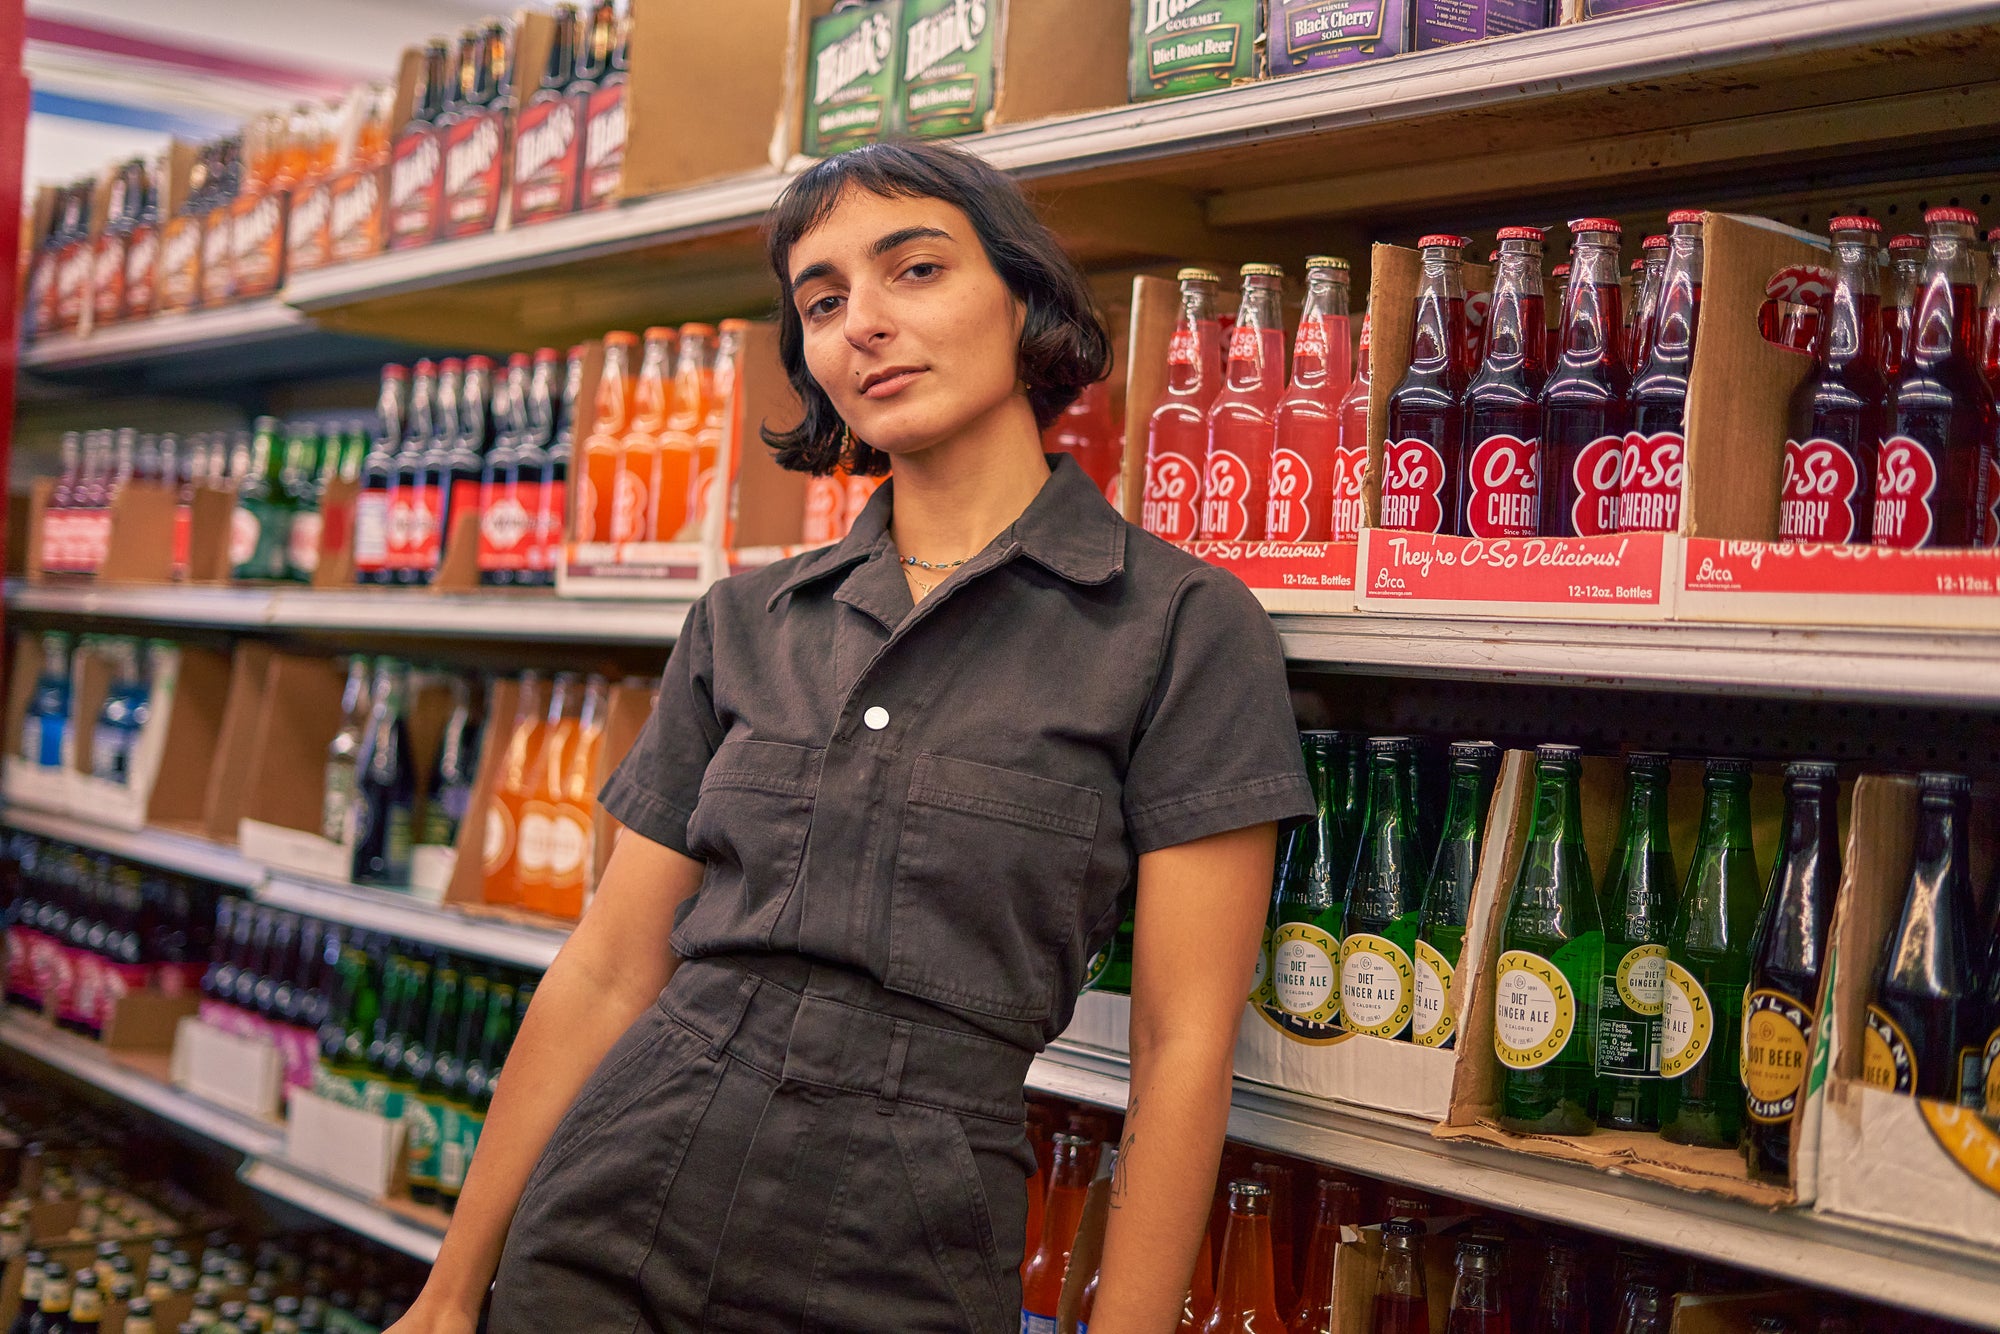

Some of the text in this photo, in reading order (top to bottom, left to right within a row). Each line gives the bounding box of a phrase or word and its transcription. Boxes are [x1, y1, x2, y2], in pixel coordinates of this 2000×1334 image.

[1165, 11, 1222, 32] GOURMET
[1295, 10, 1375, 37] Black Cherry
[1321, 29, 1344, 41] SODA
[1153, 38, 1233, 66] Diet Root Beer
[1332, 457, 1369, 496] O-S
[1382, 448, 1429, 489] O-So
[1621, 443, 1684, 488] O-So
[1781, 452, 1839, 494] O-So
[1877, 447, 1916, 494] -So
[1330, 498, 1360, 533] PEAC
[1381, 494, 1421, 527] HERRY
[1619, 492, 1677, 529] CHERRY
[1872, 499, 1906, 537] ERRY
[1503, 528, 1520, 536] Since
[1388, 533, 1629, 578] They're O-So Delicious!
[1282, 574, 1351, 587] 12-12oz. Bottles
[1374, 567, 1406, 589] Orca
[1696, 557, 1733, 582] Orca
[1568, 585, 1653, 599] 12-12oz. Bottles
[1275, 928, 1340, 965] OYLAN
[1290, 960, 1307, 973] DIET
[1343, 940, 1410, 978] OYLAN
[1420, 948, 1452, 990] LAN
[1622, 947, 1663, 970] BOYL
[1278, 972, 1327, 987] GINGER ALE
[1358, 972, 1375, 986] DIET
[1498, 957, 1567, 1001] OYLAN
[1629, 978, 1657, 988] GINGER
[1644, 970, 1660, 980] DIET
[1326, 990, 1341, 1011] CO
[1344, 984, 1396, 1001] GINGER ALE
[1511, 992, 1528, 1006] DIET
[1669, 968, 1704, 1012] LAN
[1394, 1004, 1409, 1024] CO
[1423, 999, 1439, 1011] ALE
[1498, 1004, 1550, 1024] GINGER ALE
[1436, 1016, 1452, 1036] CO
[1672, 1020, 1687, 1034] ALE
[1547, 1028, 1564, 1048] CO
[1868, 1012, 1908, 1066] LAN
[1496, 1040, 1543, 1062] TTLING
[1685, 1040, 1701, 1059] CO
[1768, 1047, 1802, 1069] BEER
[1749, 1097, 1794, 1115] TLING
